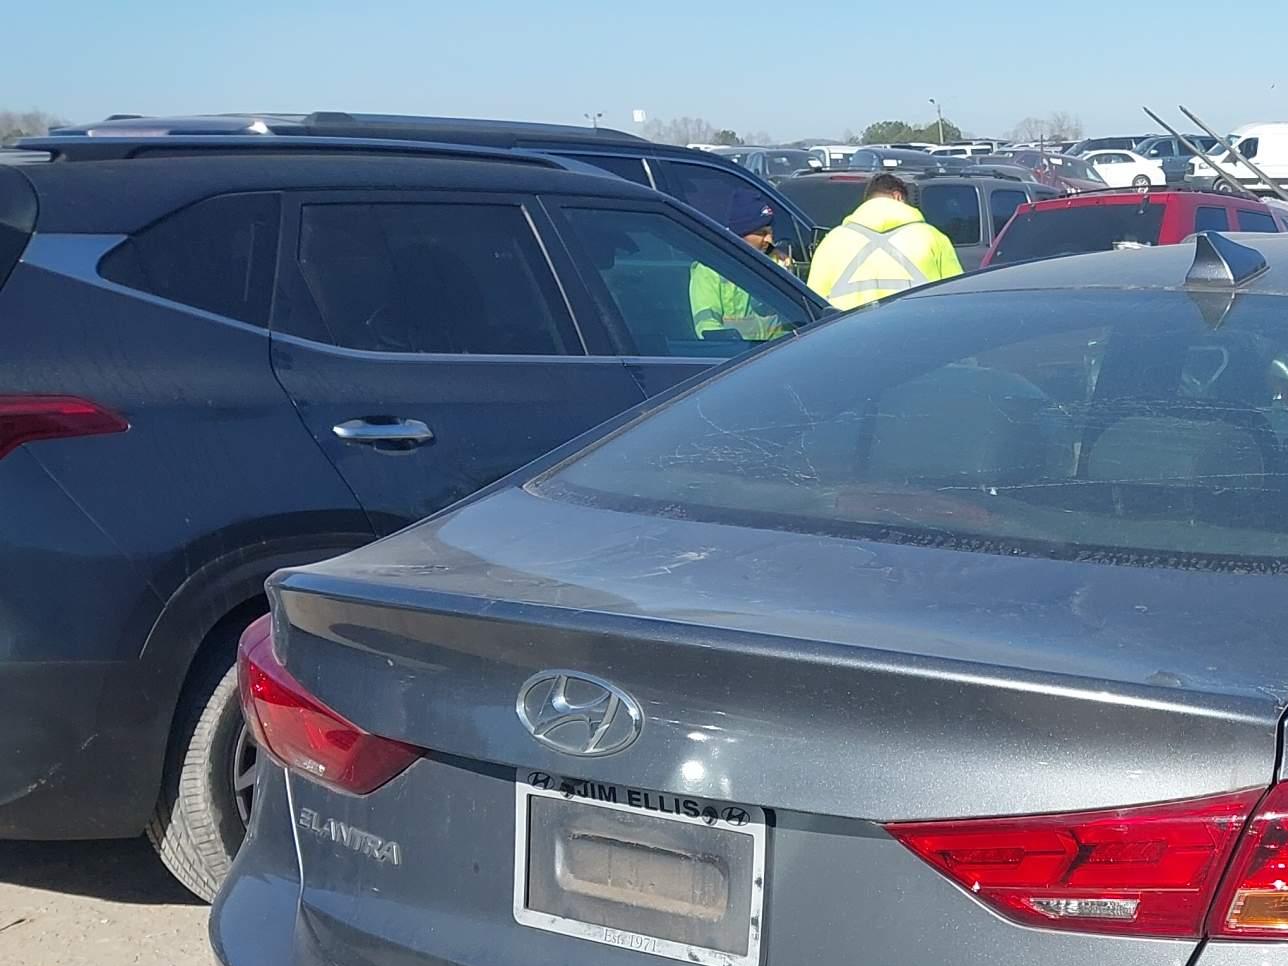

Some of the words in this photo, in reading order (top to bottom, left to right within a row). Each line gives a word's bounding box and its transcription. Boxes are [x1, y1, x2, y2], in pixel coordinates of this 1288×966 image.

[577, 782, 617, 804] JIM
[627, 789, 701, 818] ELLIS
[299, 807, 400, 865] ELANTRA
[630, 934, 657, 953] 1971
